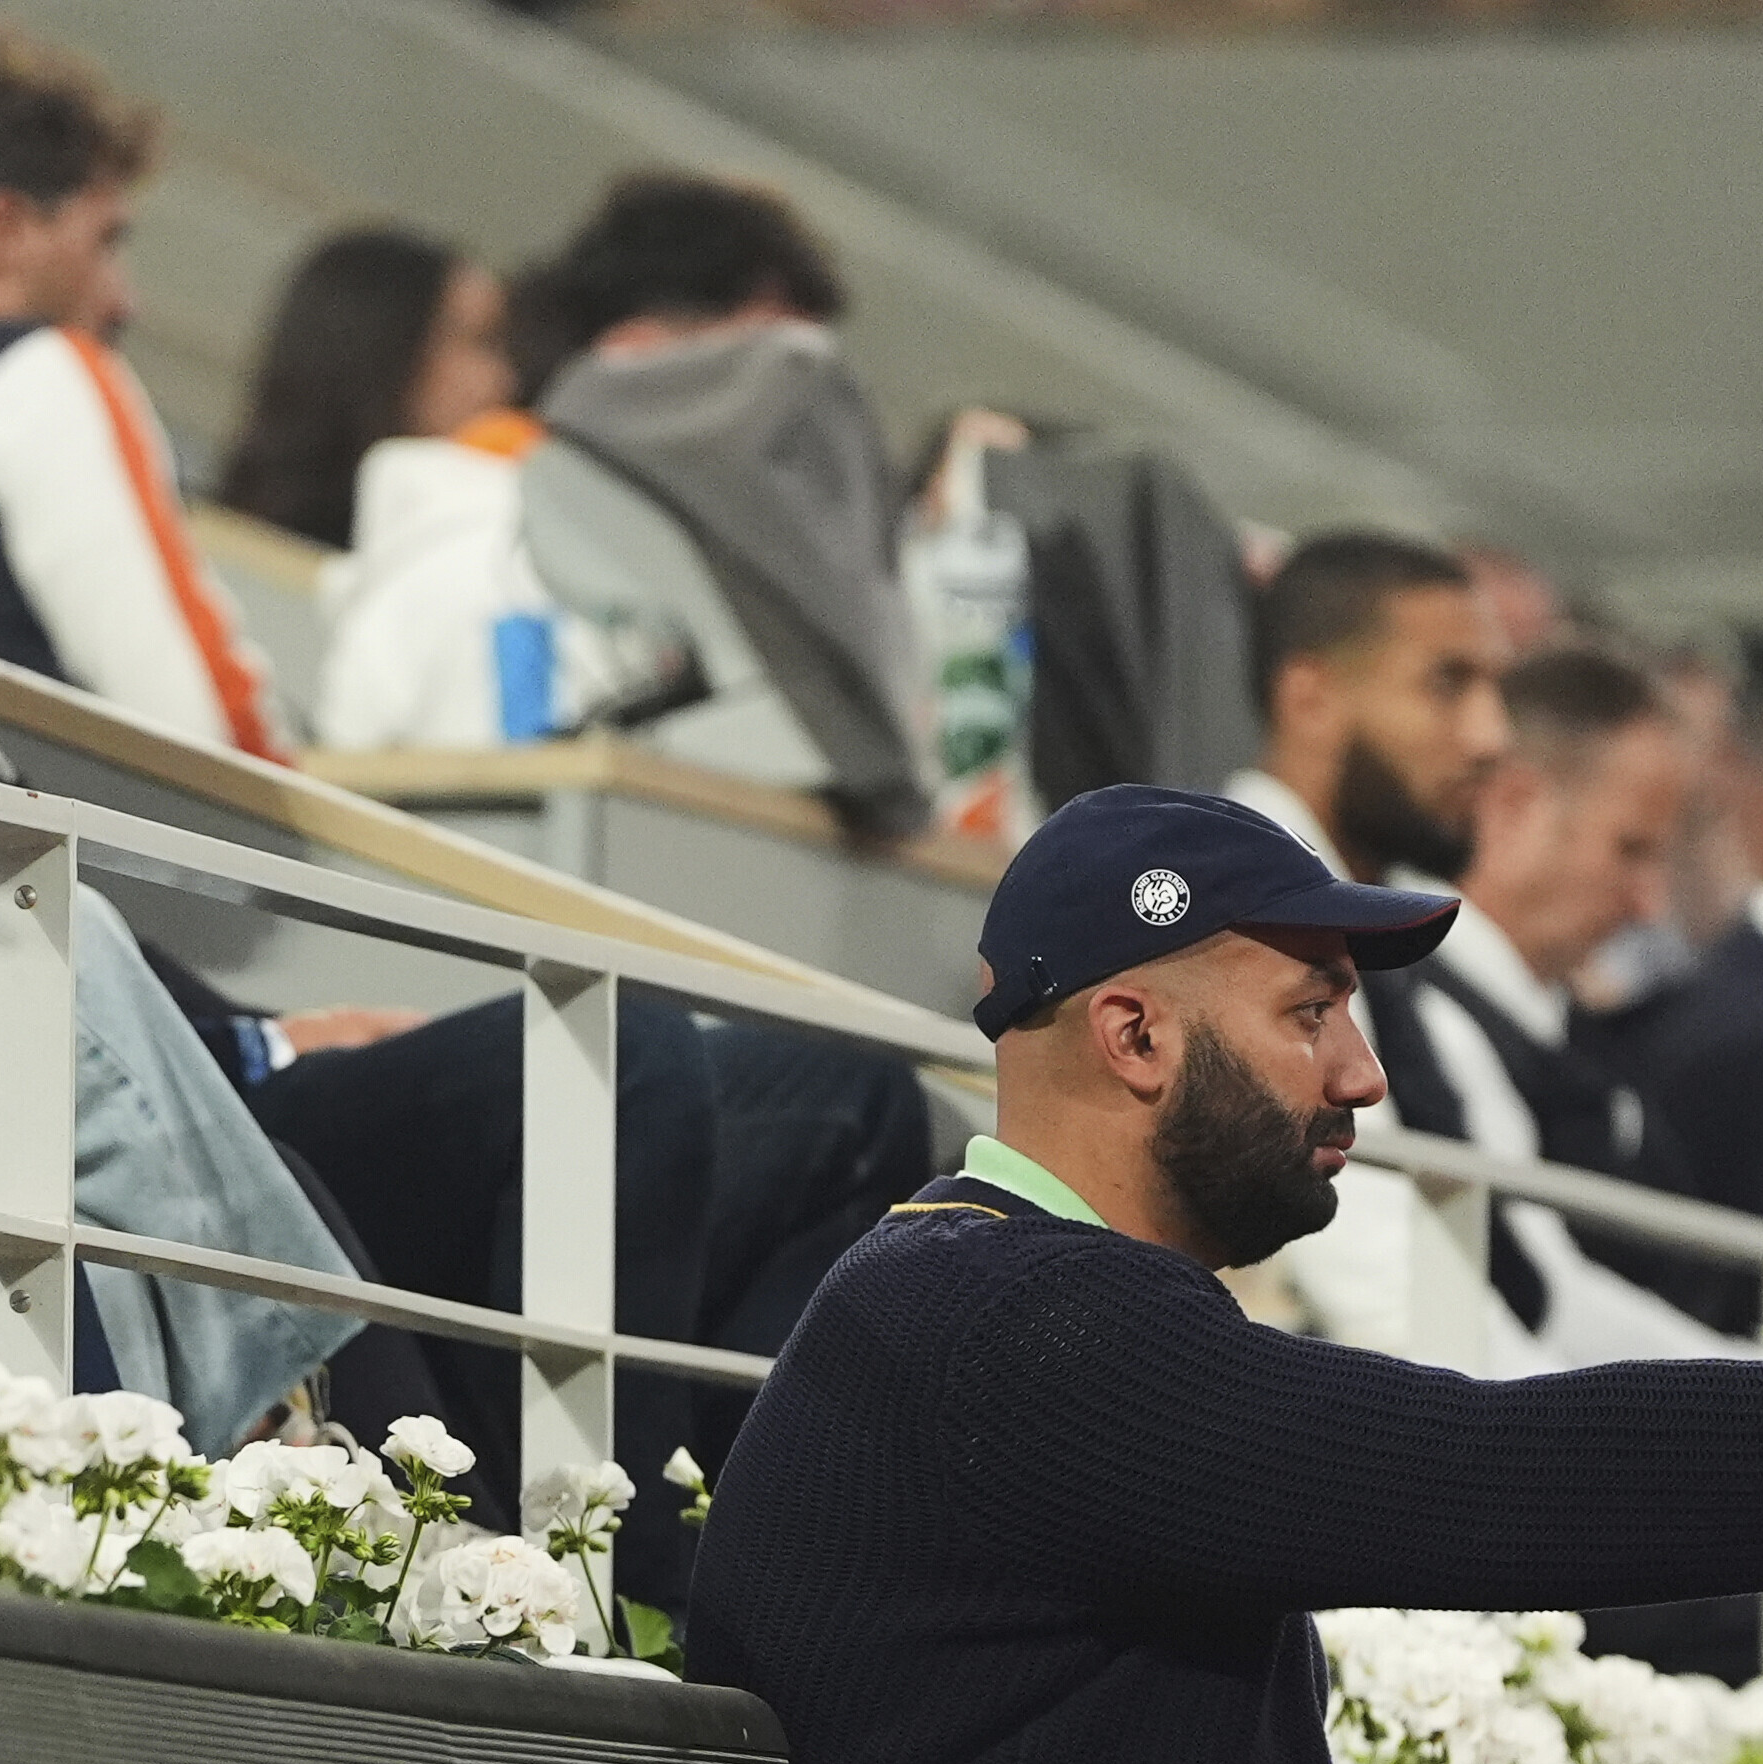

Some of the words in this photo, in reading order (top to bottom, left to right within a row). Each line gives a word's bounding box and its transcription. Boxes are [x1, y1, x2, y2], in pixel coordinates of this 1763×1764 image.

[1135, 876, 1151, 914] ROLAND
[1150, 871, 1187, 895] GARROS
[1150, 901, 1186, 923] PARIS
